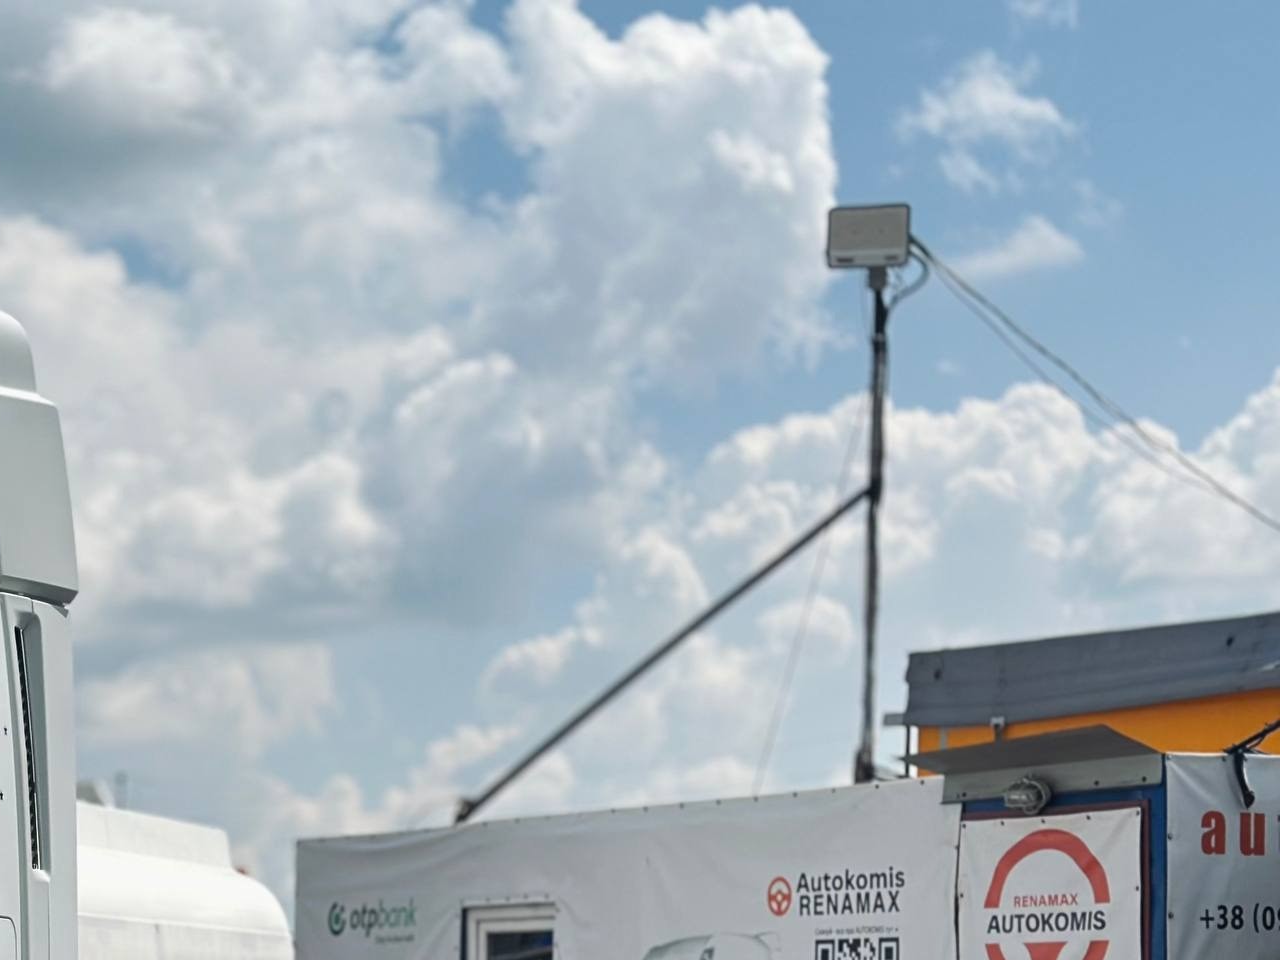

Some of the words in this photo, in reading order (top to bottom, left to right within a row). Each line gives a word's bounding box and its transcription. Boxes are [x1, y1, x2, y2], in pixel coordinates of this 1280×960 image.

[1200, 810, 1280, 857] au
[797, 866, 905, 893] Autokomis
[799, 890, 901, 917] RENAMAX
[1013, 893, 1079, 908] RENAMAX
[987, 910, 1107, 934] AUTOKOMIS
[1200, 905, 1244, 930] +38
[1253, 903, 1280, 933] (0
